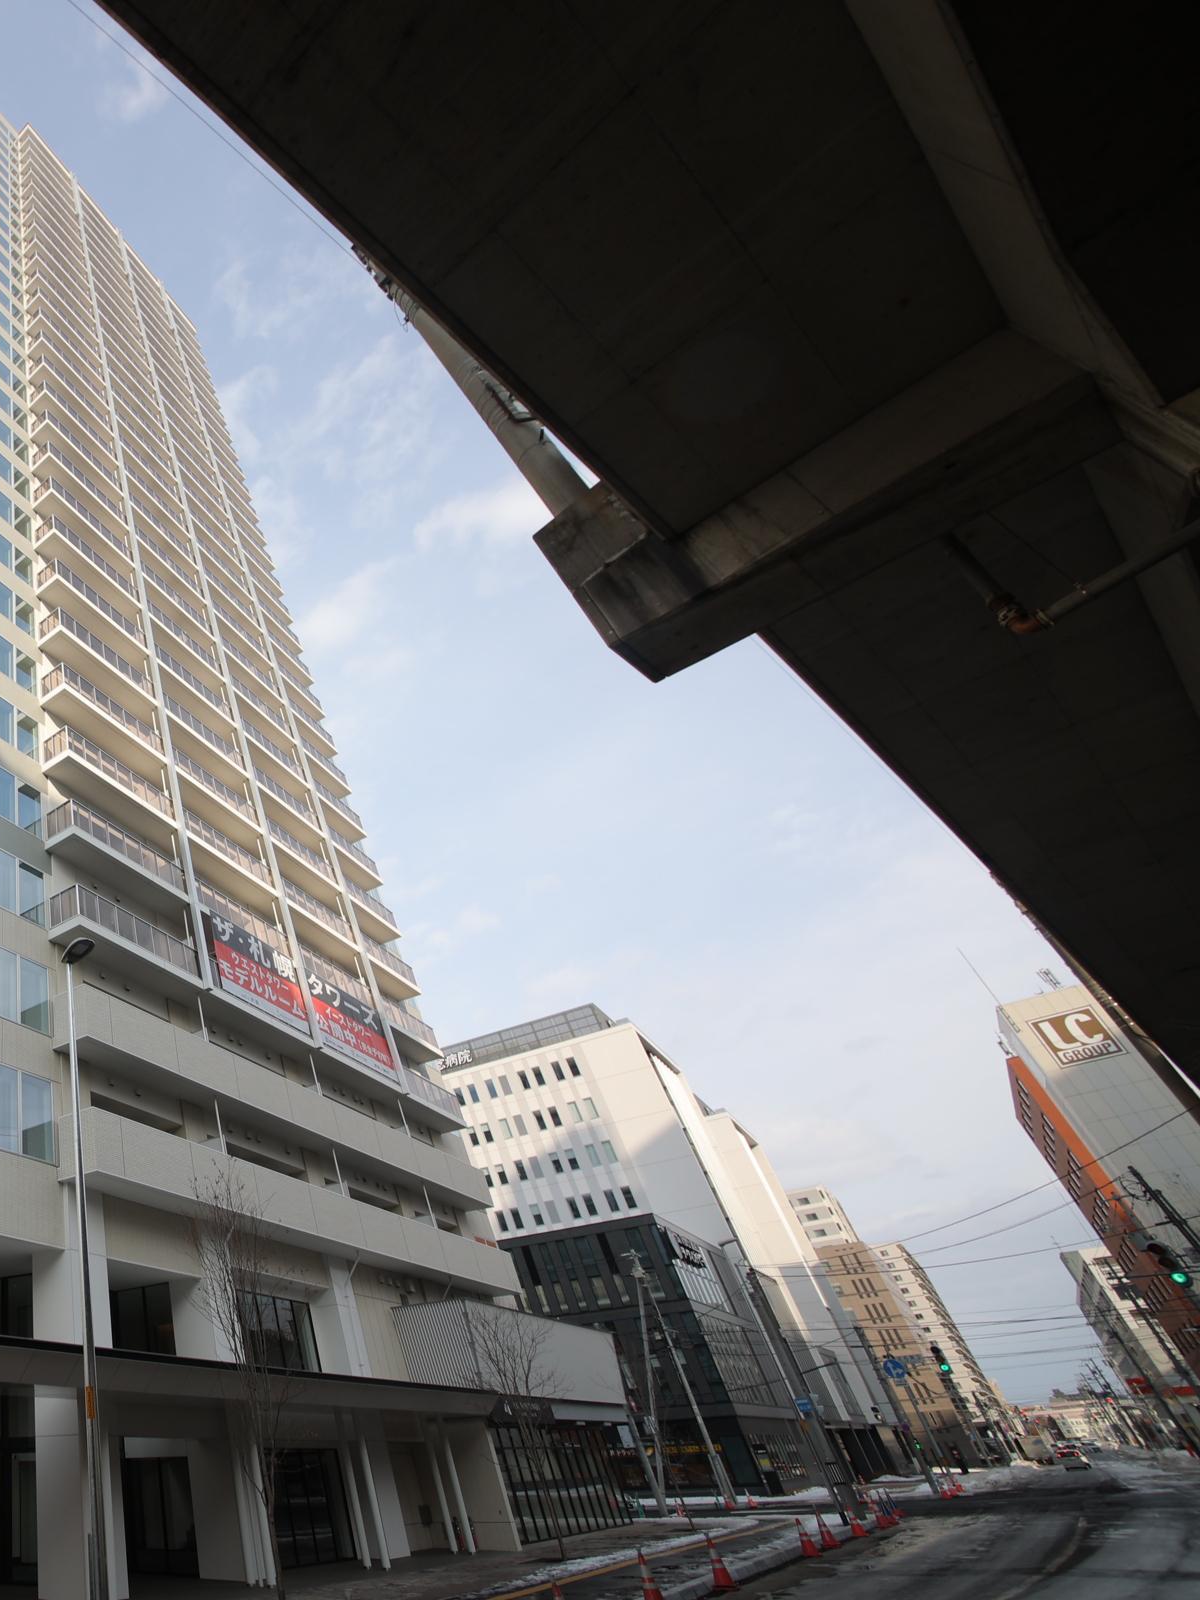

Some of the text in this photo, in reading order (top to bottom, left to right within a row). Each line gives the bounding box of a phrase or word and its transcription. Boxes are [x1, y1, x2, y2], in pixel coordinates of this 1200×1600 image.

[219, 959, 306, 1018] モデルルーム
[1038, 1013, 1104, 1050] LC
[1062, 1042, 1112, 1062] GROUP
